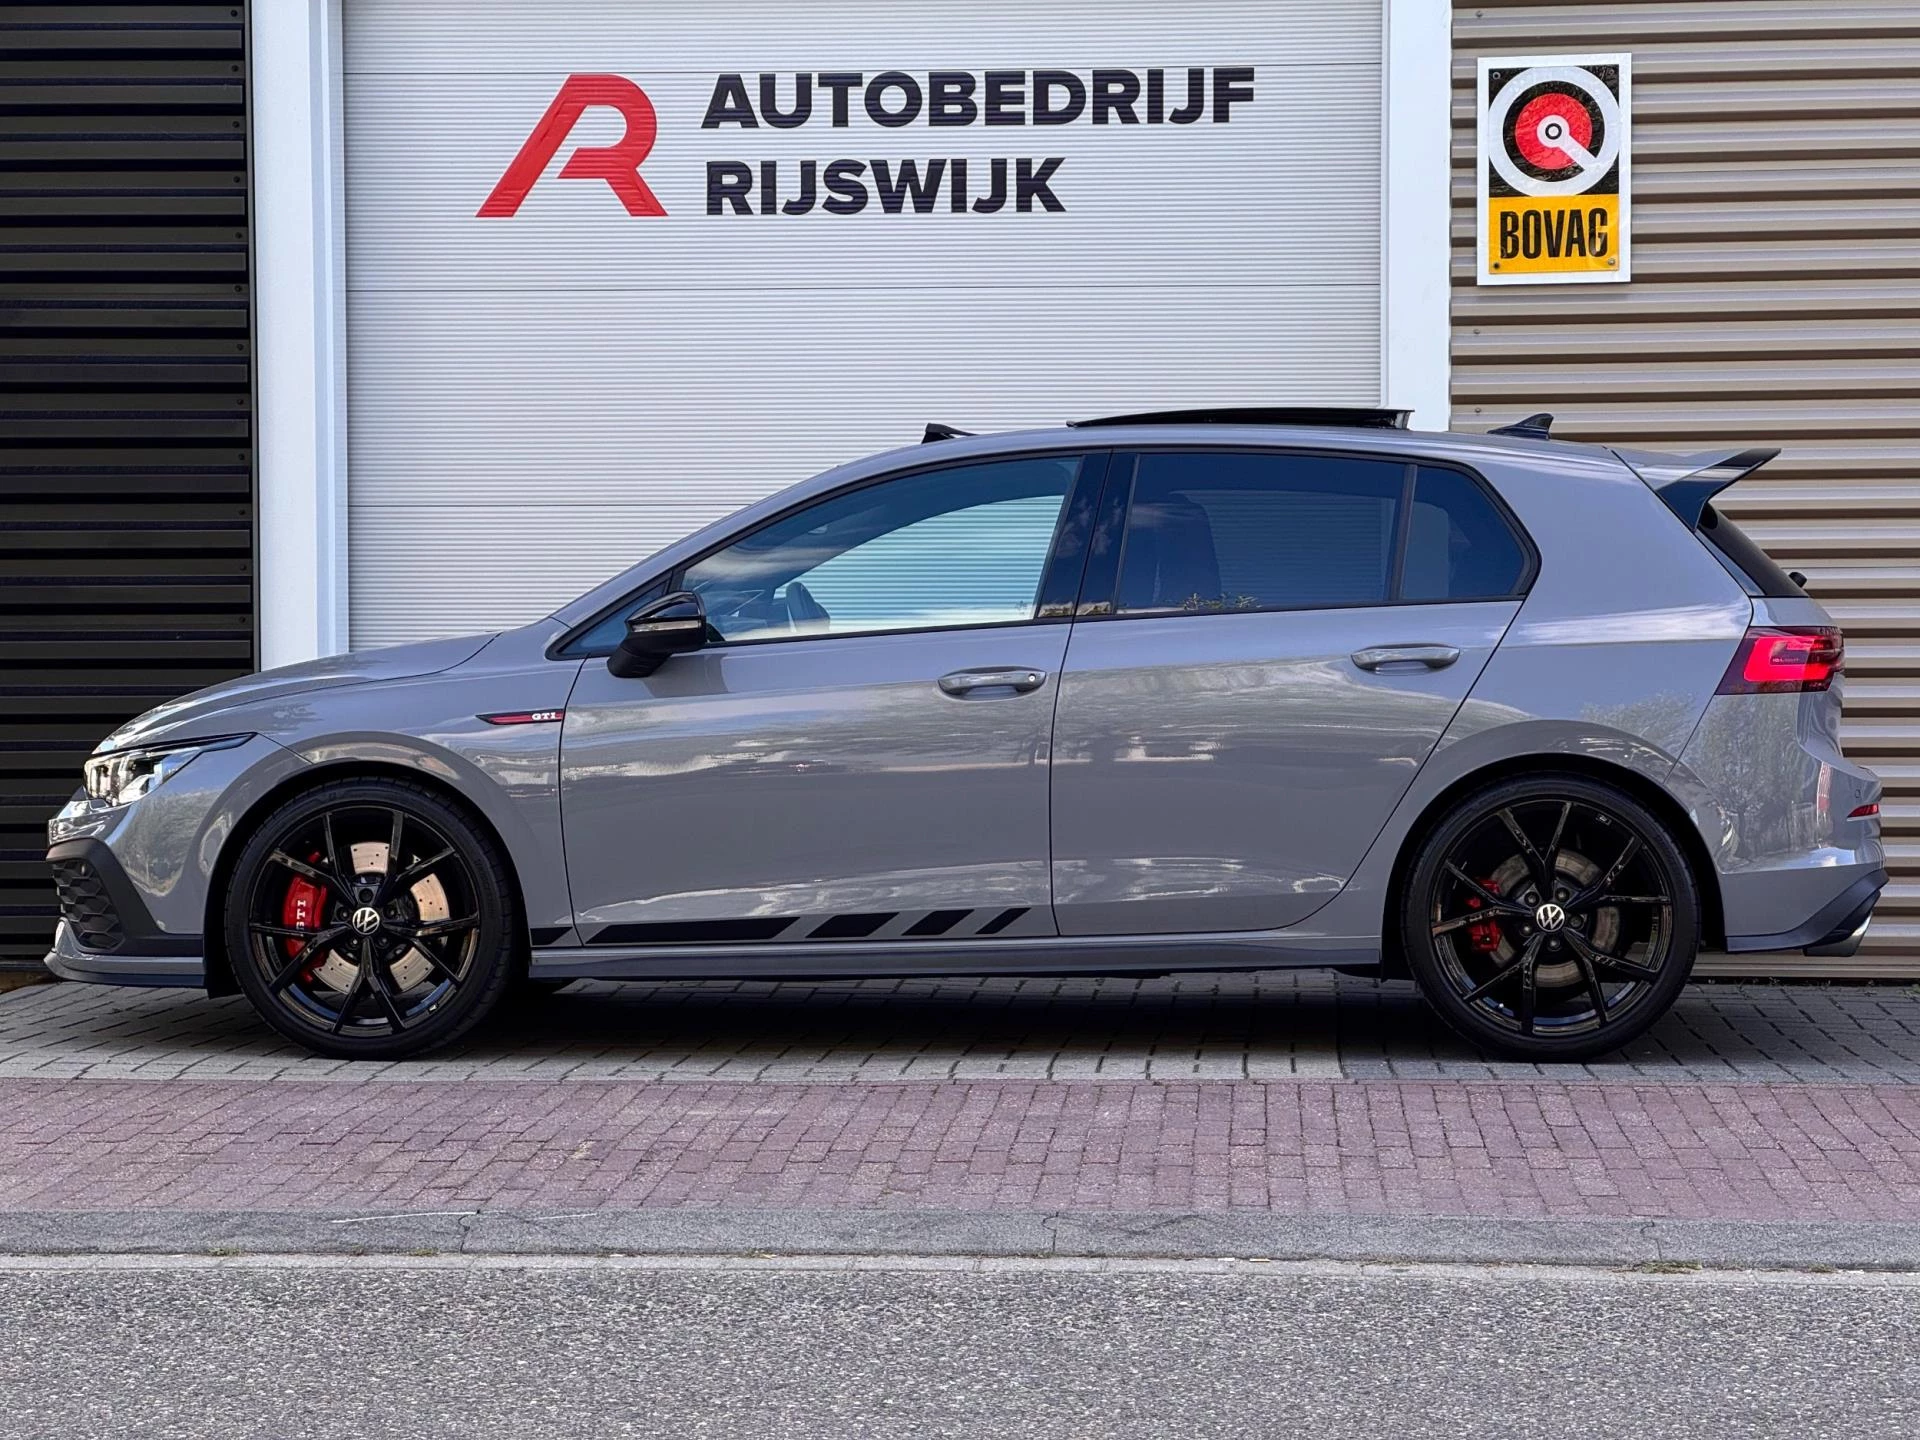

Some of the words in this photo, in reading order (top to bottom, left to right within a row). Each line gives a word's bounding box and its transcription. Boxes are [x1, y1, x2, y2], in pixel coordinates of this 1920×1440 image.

[700, 67, 1255, 129] AUTOBEDRIJF
[706, 158, 1067, 215] RIJSWIJK
[1500, 207, 1608, 260] BOVAG
[531, 711, 557, 721] GTI
